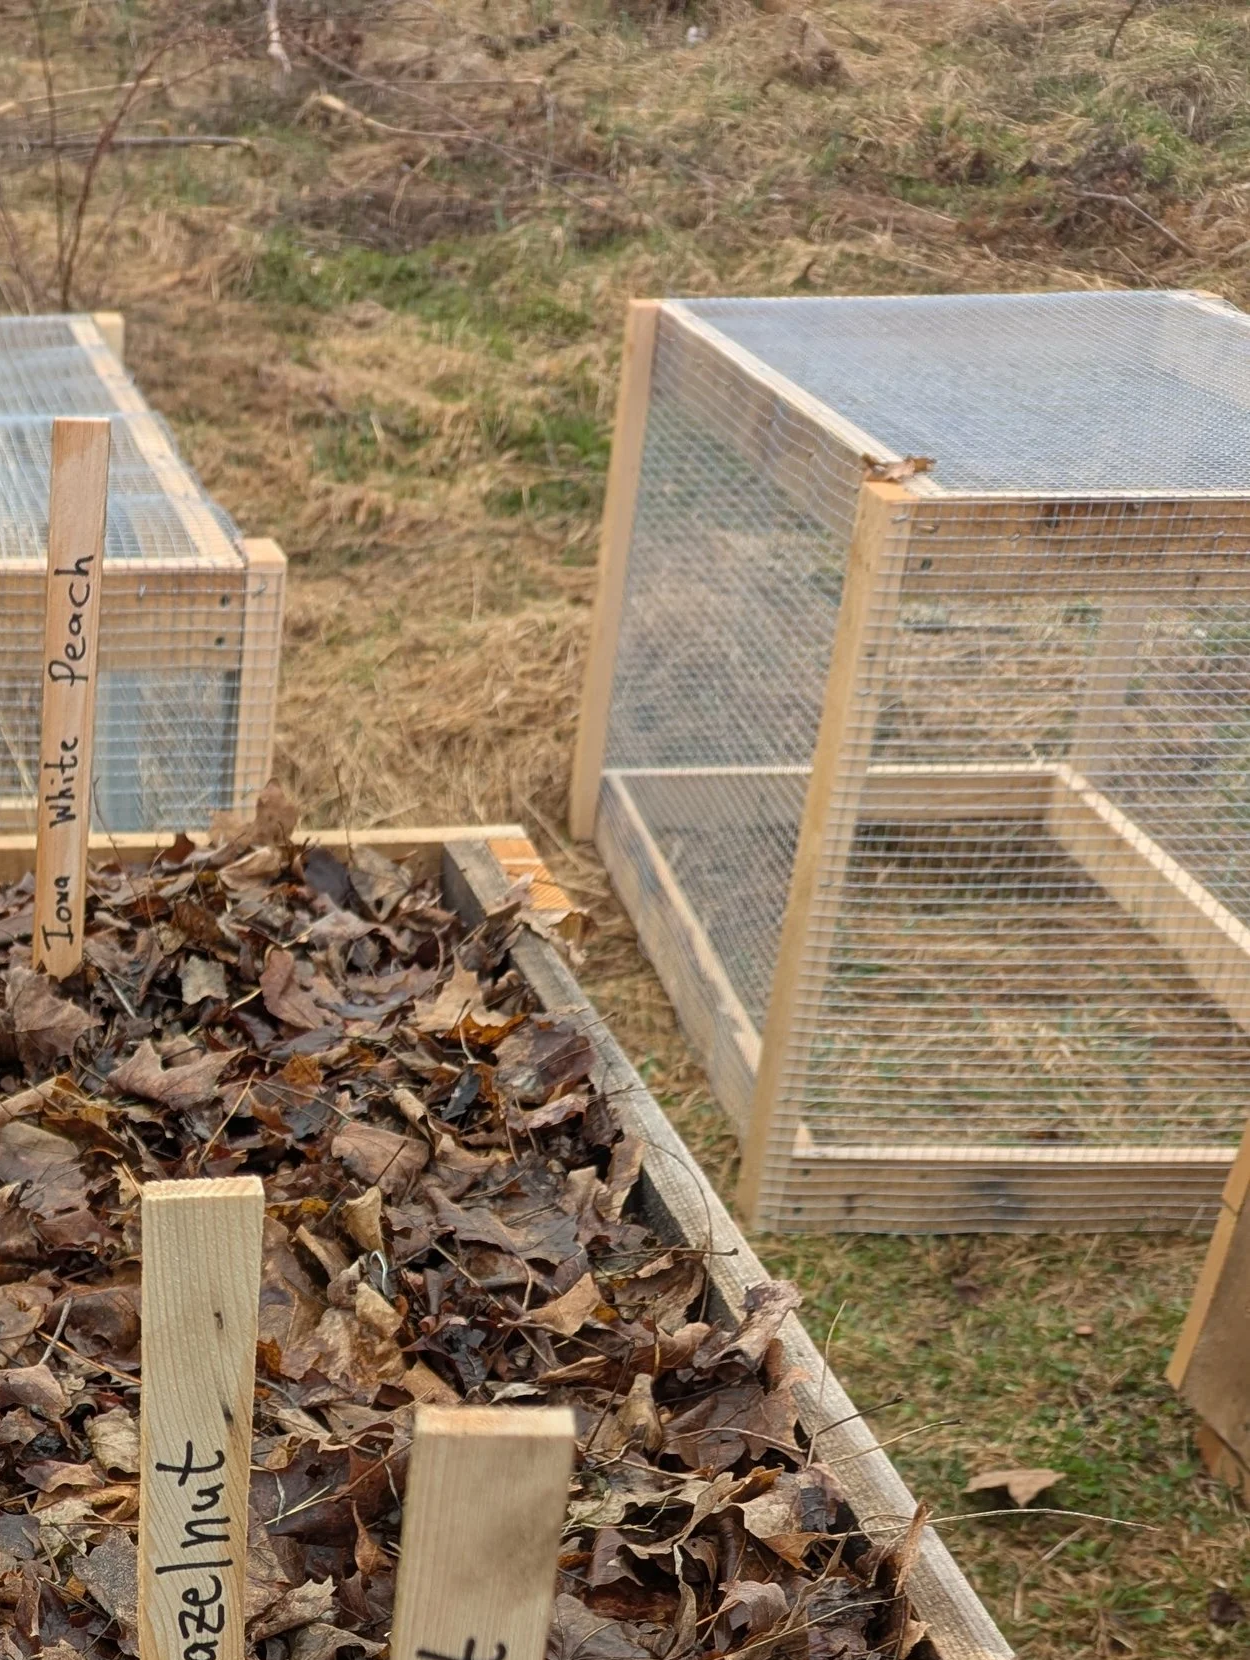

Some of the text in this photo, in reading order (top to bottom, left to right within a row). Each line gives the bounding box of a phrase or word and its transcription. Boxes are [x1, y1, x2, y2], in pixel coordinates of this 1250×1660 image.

[42, 554, 95, 952] Iowa White Peach
